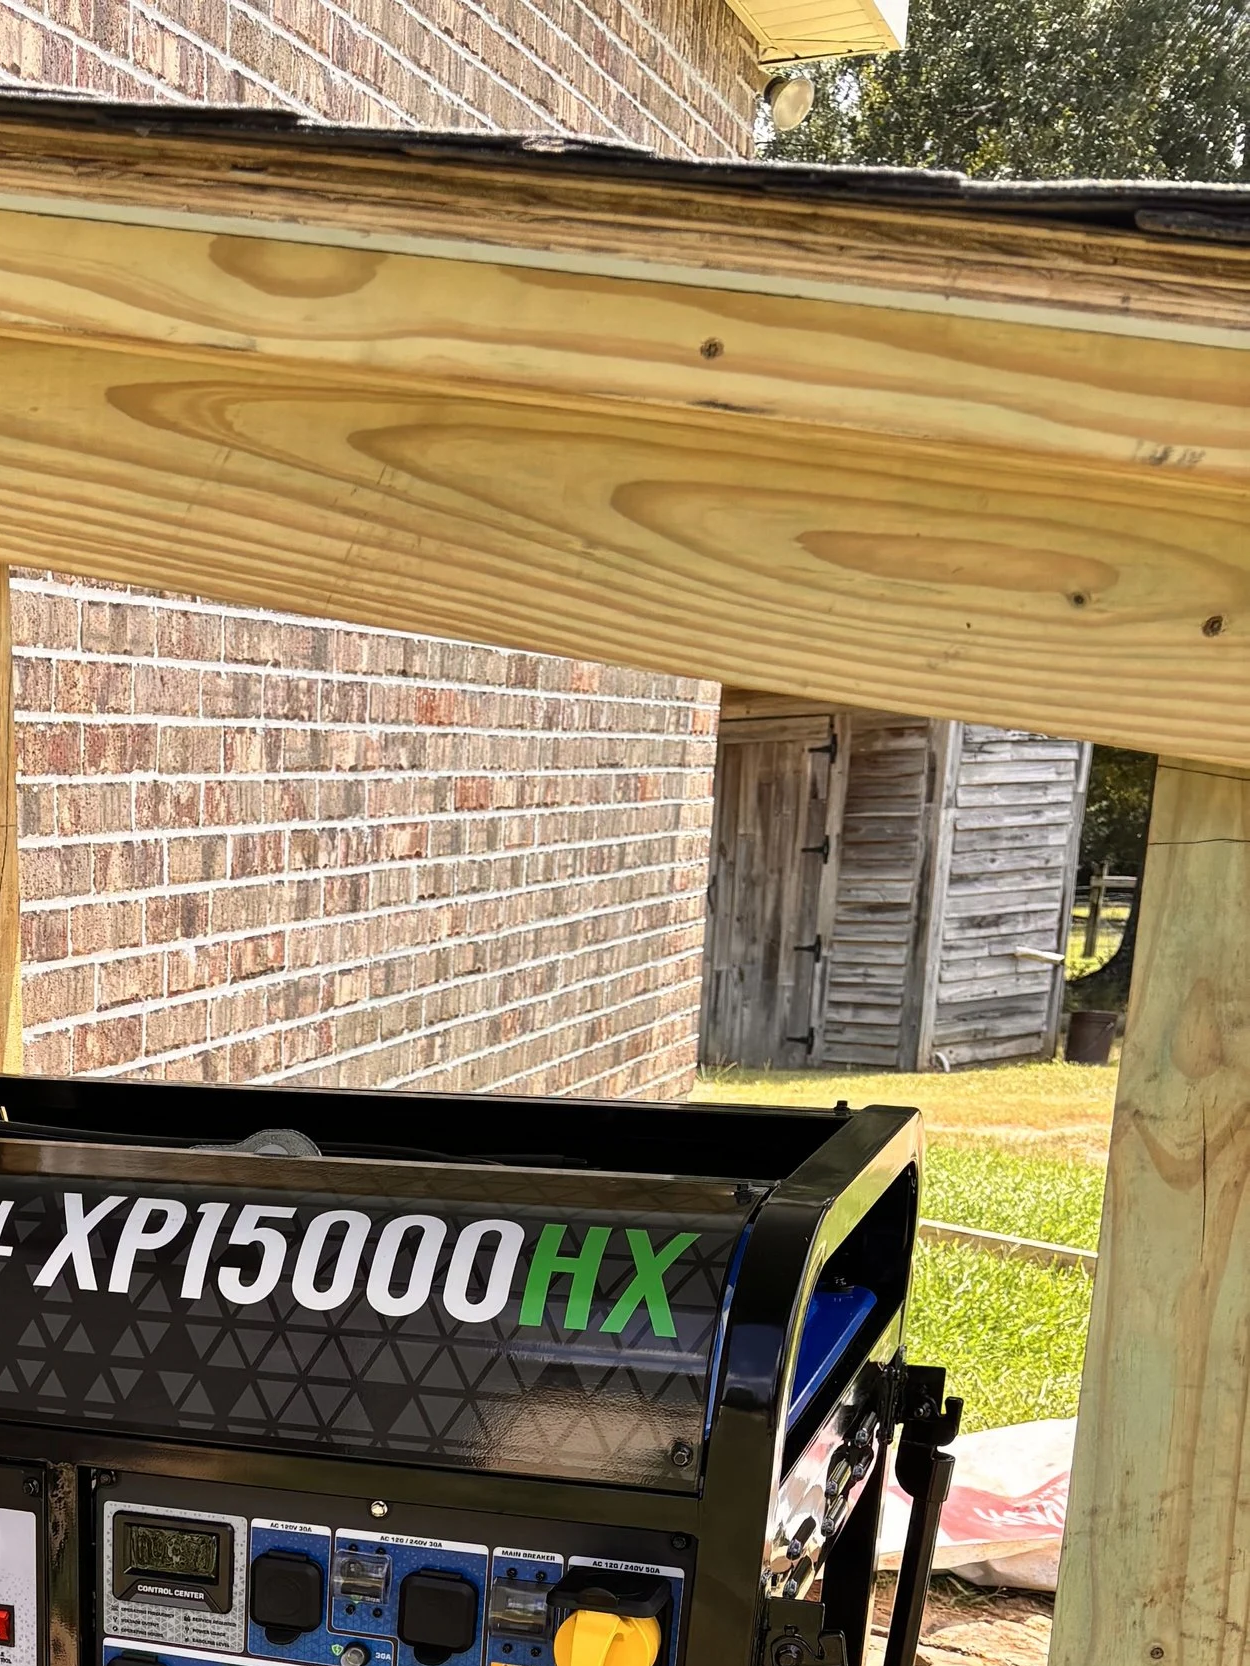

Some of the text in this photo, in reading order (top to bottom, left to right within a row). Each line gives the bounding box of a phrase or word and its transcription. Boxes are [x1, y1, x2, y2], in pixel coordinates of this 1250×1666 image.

[33, 1192, 702, 1338] XP15000HX
[269, 1522, 280, 1530] AC
[501, 1550, 556, 1562] MAIN BREAKER
[592, 1560, 603, 1568] AC
[604, 1561, 619, 1570] 120
[624, 1564, 644, 1573] 240V
[137, 1584, 205, 1600] CONTROL CENTER
[375, 1652, 391, 1661] 30A
